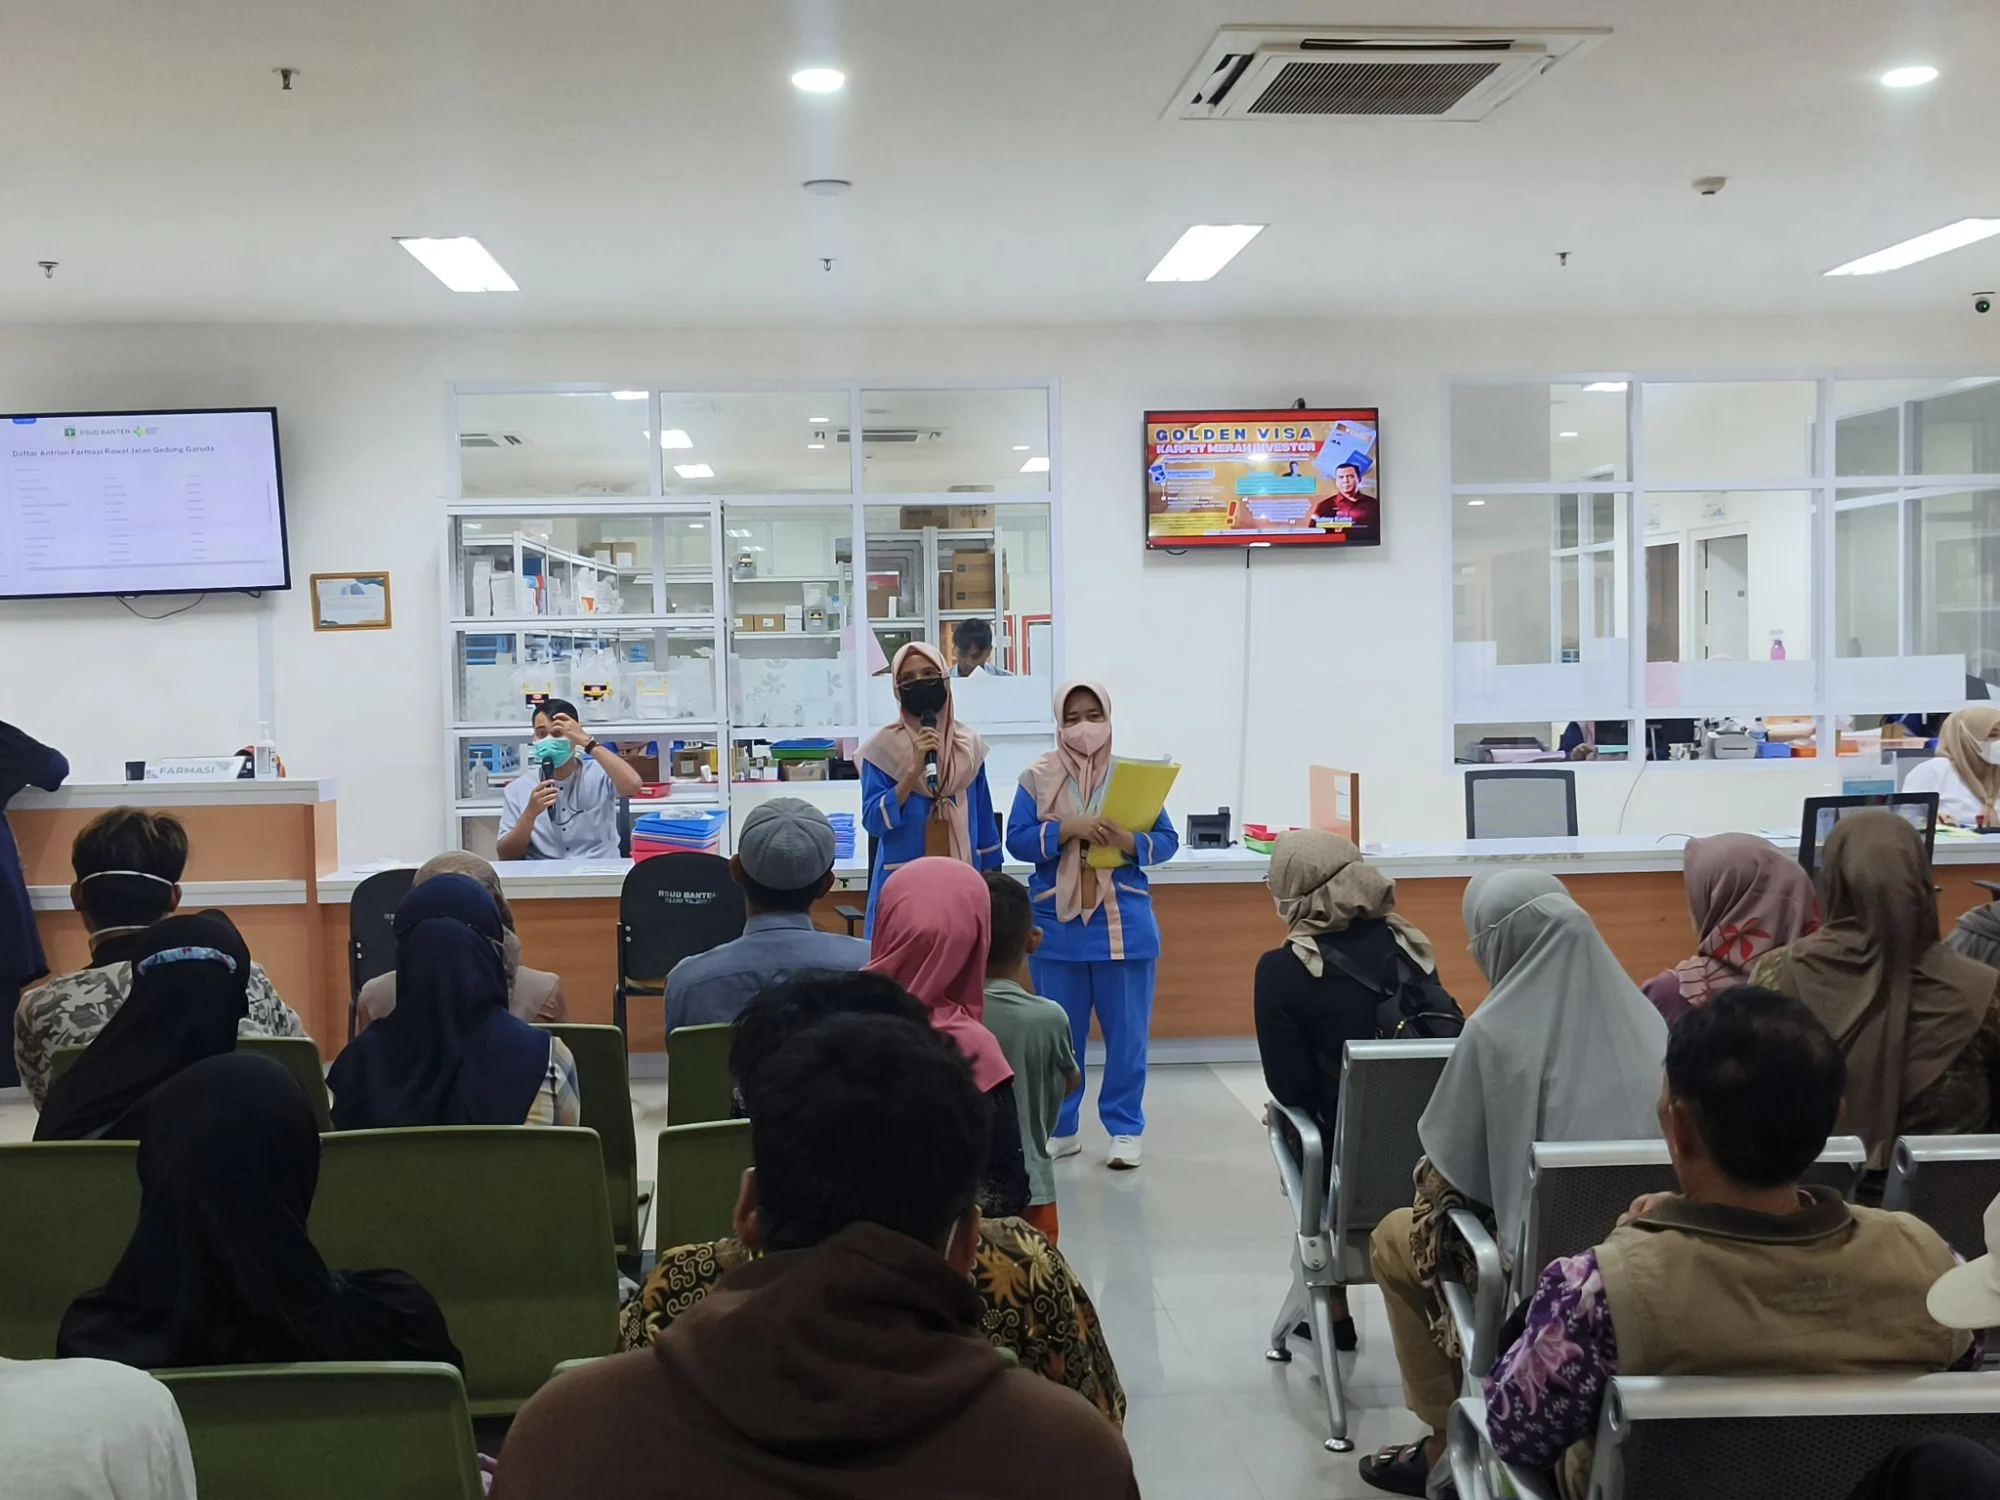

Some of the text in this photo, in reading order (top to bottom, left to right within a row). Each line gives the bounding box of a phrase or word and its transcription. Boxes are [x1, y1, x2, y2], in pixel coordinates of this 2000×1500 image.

[101, 428, 131, 436] BANTEN
[1155, 427, 1313, 441] GOLDEN VISA
[12, 449, 37, 457] Daftar
[71, 448, 103, 456] Farmasi
[153, 446, 184, 454] Gedung
[185, 445, 215, 453] Garuda
[1156, 441, 1315, 454] KARPET MERAH INVESTOR
[159, 766, 215, 775] FARMASI
